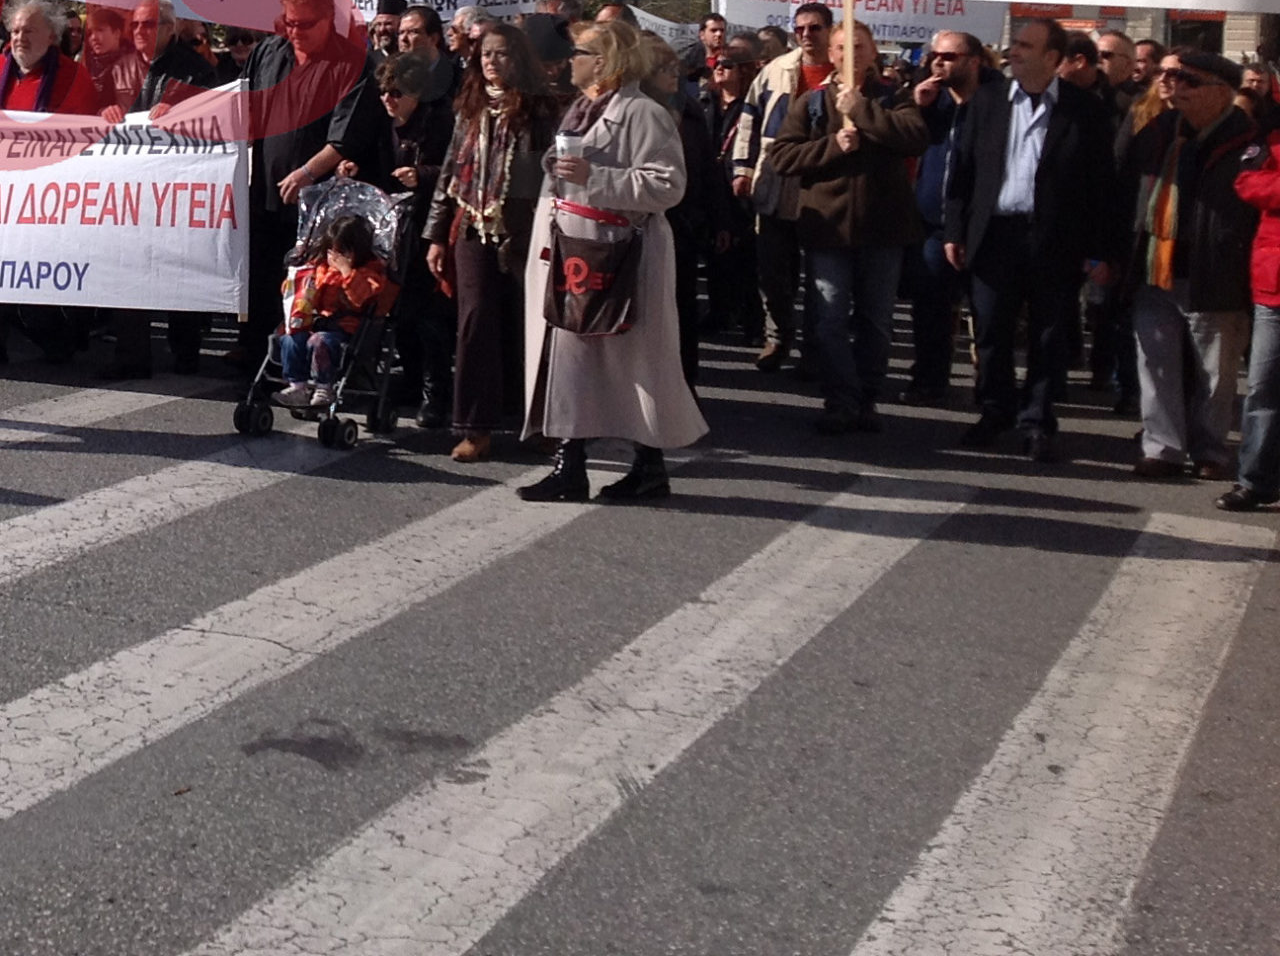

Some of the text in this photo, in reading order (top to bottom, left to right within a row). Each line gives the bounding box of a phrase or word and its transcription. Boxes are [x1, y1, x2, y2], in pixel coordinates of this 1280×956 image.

[6, 129, 77, 159] ΕΙΝΑΙ
[79, 116, 227, 158] ΣΥΝΤΕΧΝΙΑ
[16, 182, 141, 227] ΔΩΡΕΑΝ
[153, 182, 239, 231] ΥΓΕΙΑ
